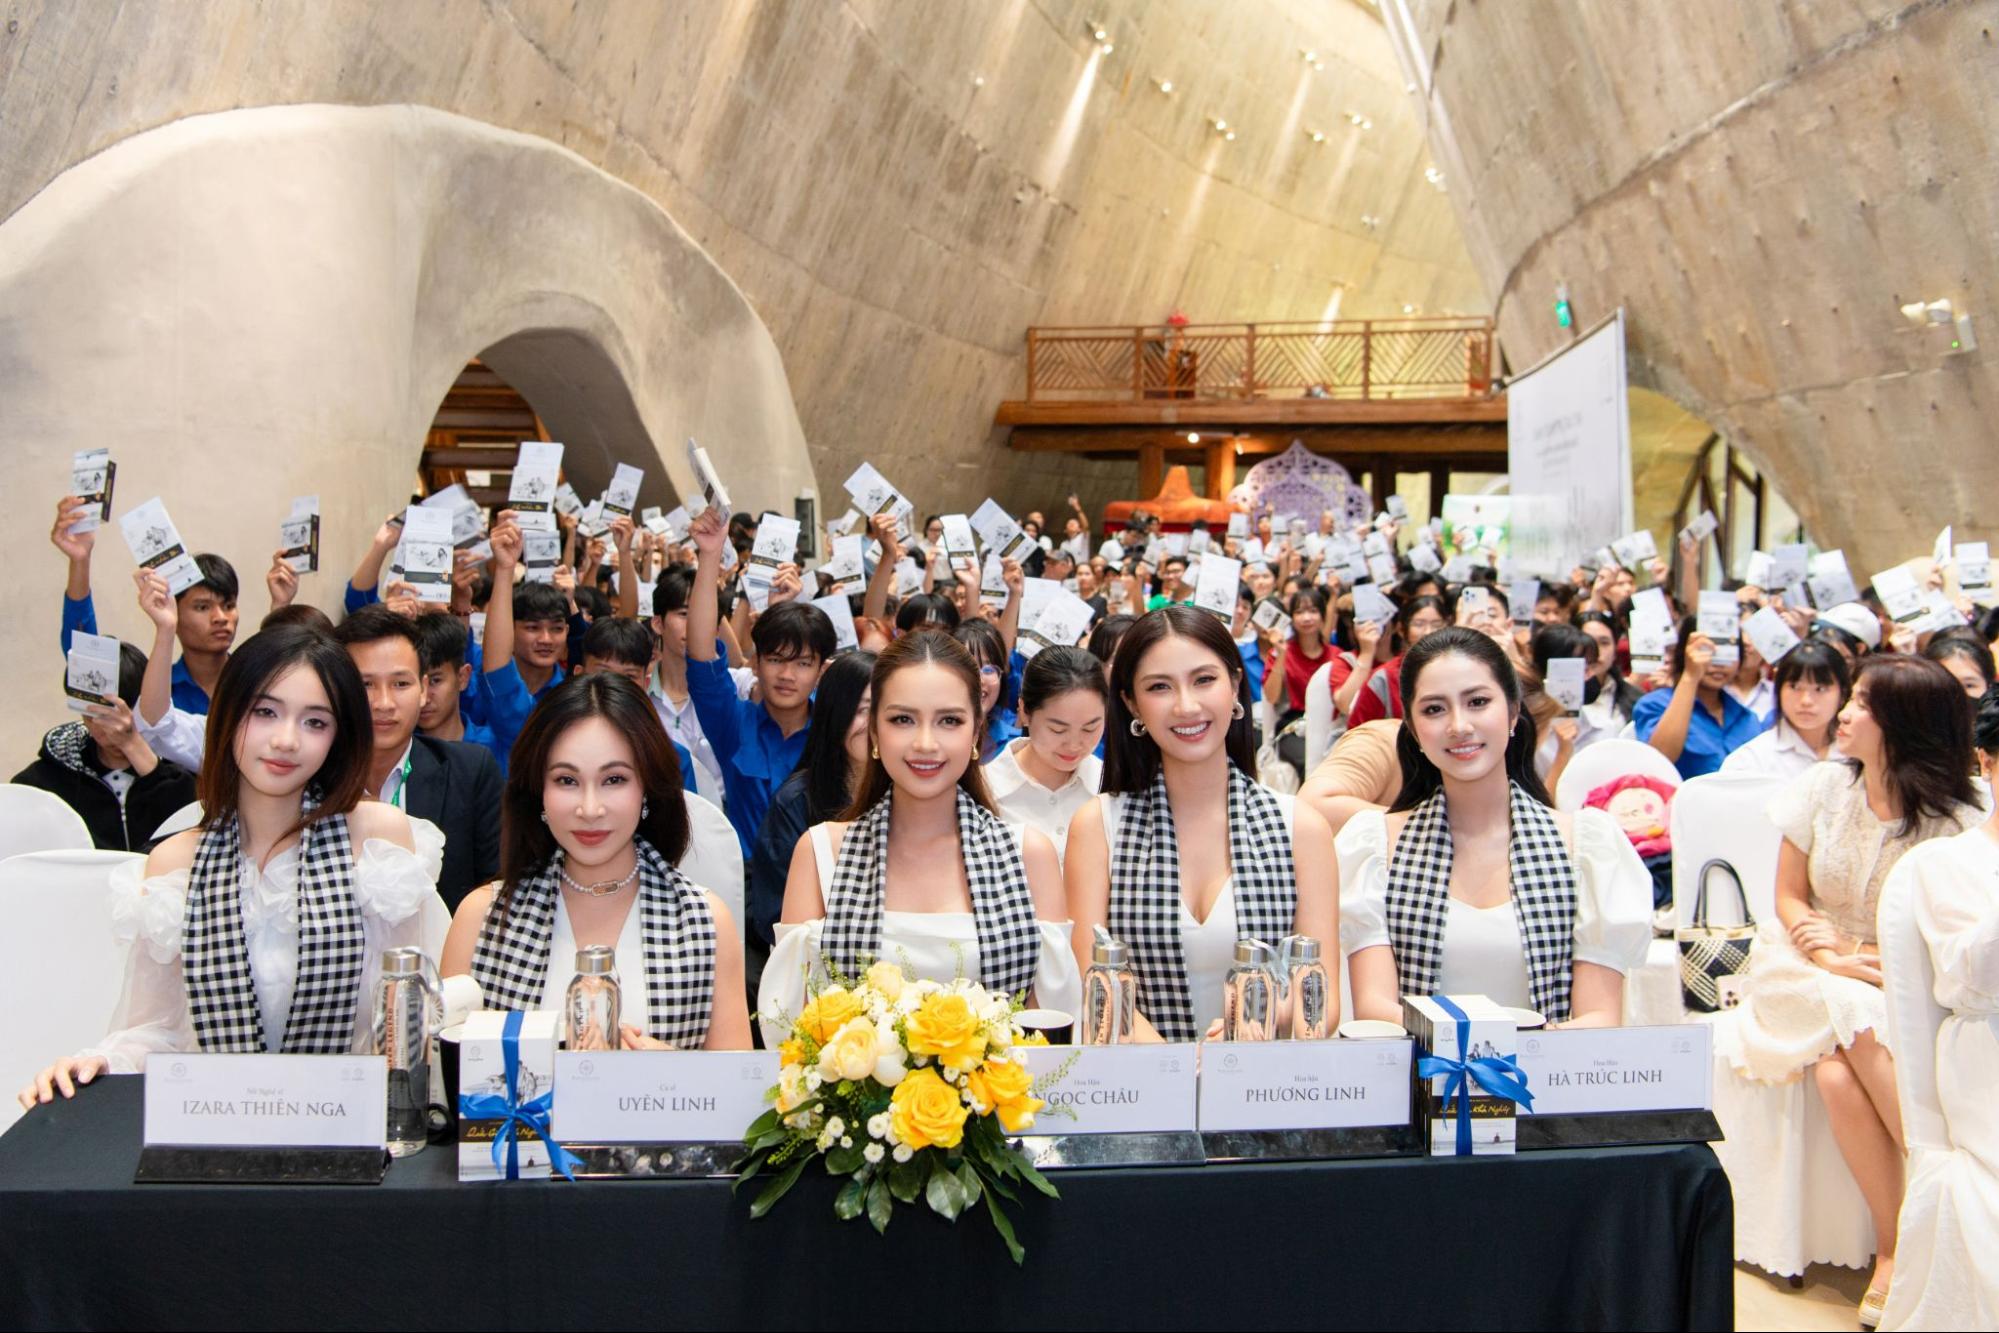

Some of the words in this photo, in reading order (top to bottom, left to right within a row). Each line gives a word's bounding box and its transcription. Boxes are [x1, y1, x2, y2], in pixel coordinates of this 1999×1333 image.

[1548, 1070, 1570, 1086] HÀ
[1575, 1068, 1618, 1085] TRÚC
[1623, 1070, 1662, 1084] LINH
[619, 1094, 665, 1111] UYÊN
[672, 1097, 716, 1111] LINH
[1091, 1088, 1139, 1104] CHÂU
[1246, 1086, 1319, 1103] PHƯƠNG
[1325, 1086, 1365, 1100] LINH
[183, 1101, 236, 1115] IZARA
[240, 1098, 300, 1116] THIÊN
[306, 1102, 346, 1117] NGA
